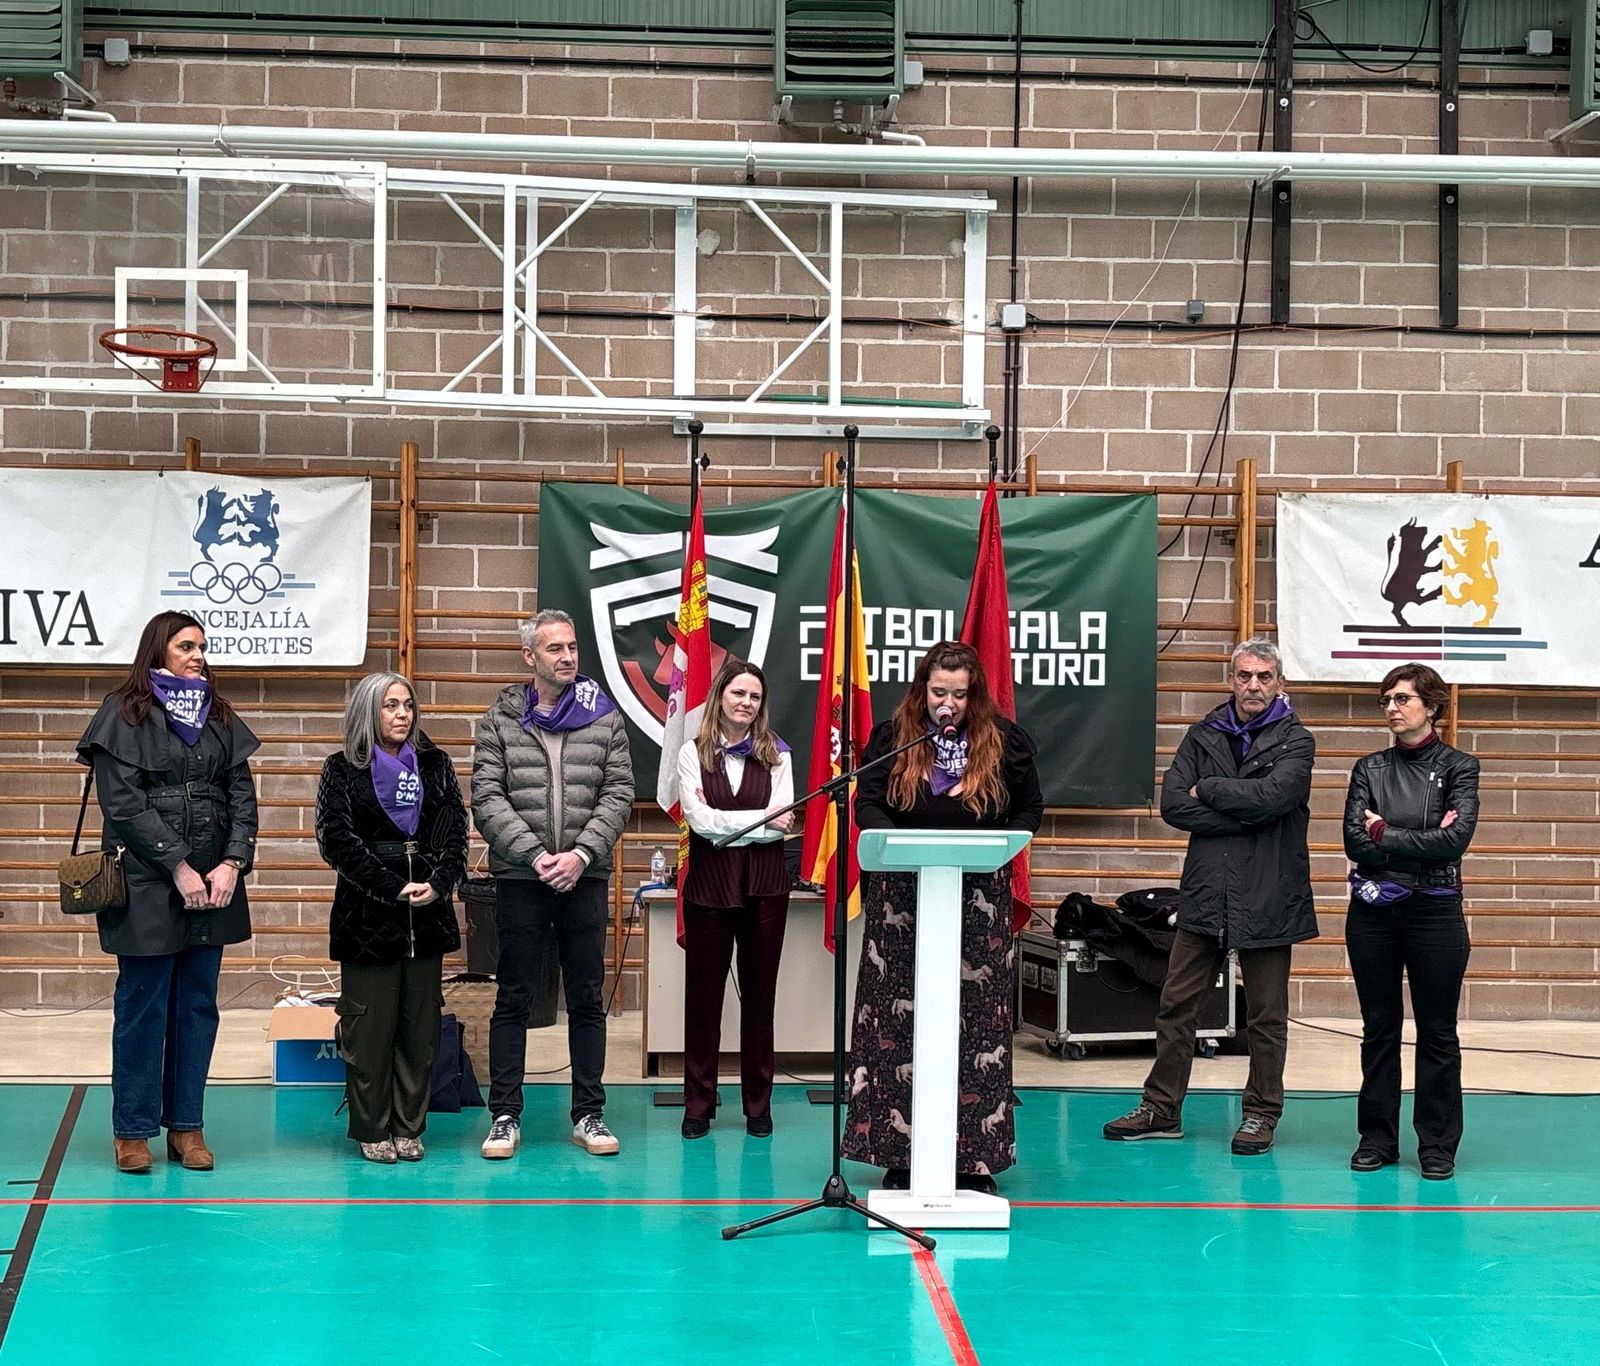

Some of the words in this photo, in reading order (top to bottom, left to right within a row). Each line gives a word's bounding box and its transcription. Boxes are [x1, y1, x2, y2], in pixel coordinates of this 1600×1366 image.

[167, 607, 311, 631] NCEJALÍA
[799, 605, 960, 647] FTBOL
[204, 635, 313, 655] EPORTES
